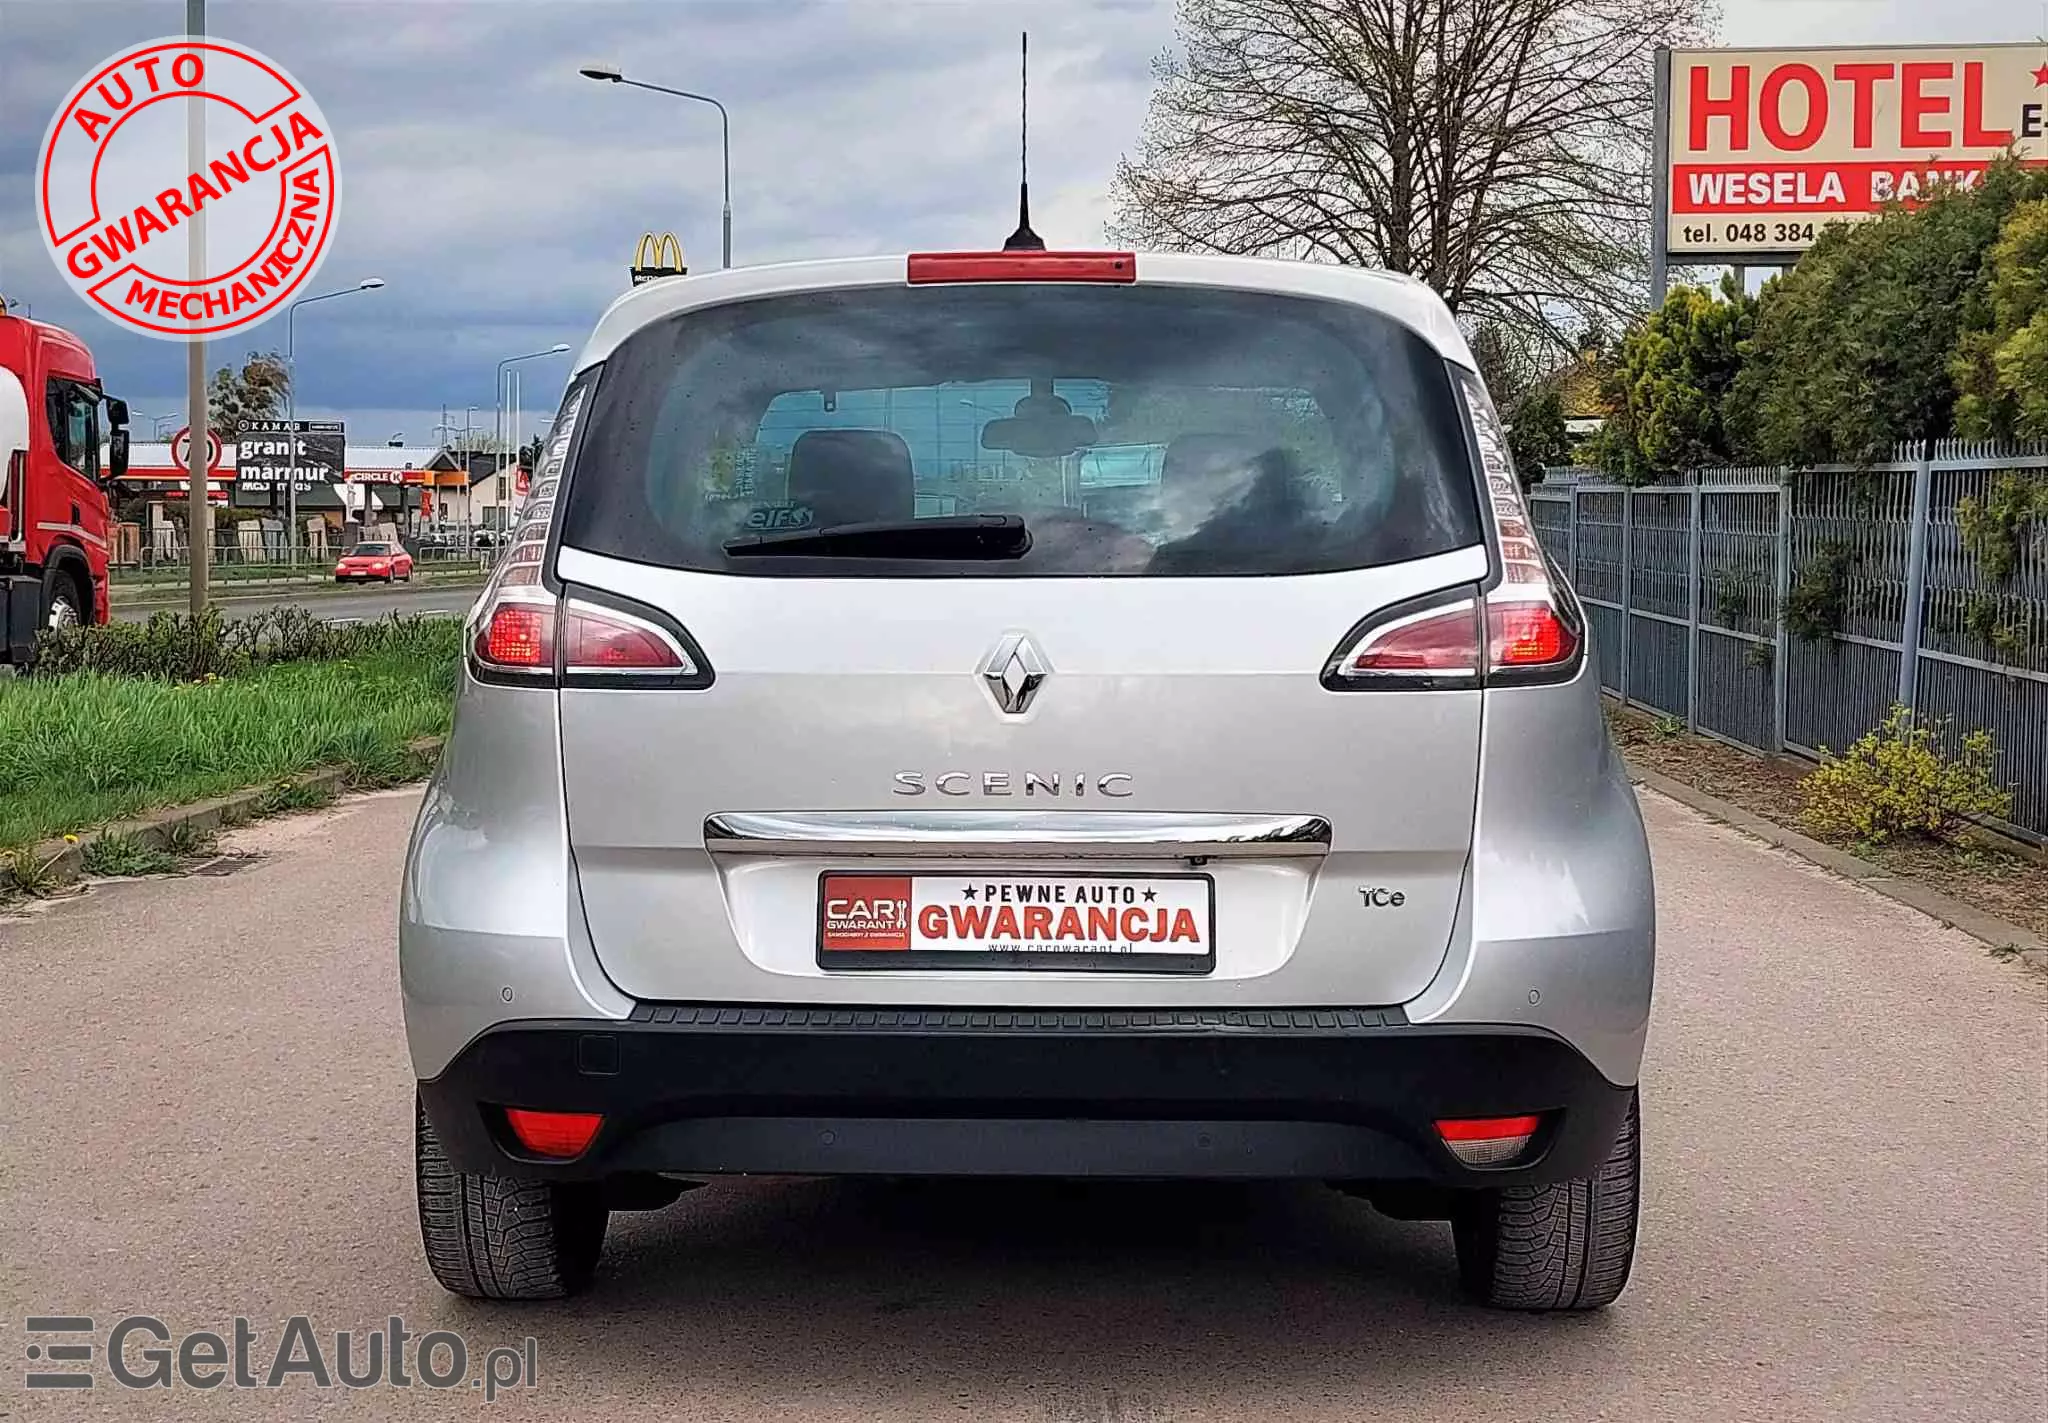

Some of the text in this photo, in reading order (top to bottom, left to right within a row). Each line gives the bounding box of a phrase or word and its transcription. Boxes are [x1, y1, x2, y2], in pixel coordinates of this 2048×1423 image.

[1688, 61, 2013, 152] HOTEL
[1689, 171, 1845, 205] WESELA
[1683, 223, 1815, 242] tel. 048 384
[240, 466, 329, 481] marmur
[355, 473, 389, 481] CIRCLE
[893, 771, 1133, 797] SCENIC
[985, 884, 1136, 904] PEWNE AUTO
[1358, 886, 1406, 907] TCe
[827, 899, 896, 920] CAR
[827, 920, 895, 930] GWARANT
[918, 904, 1200, 943] GWARANCJA
